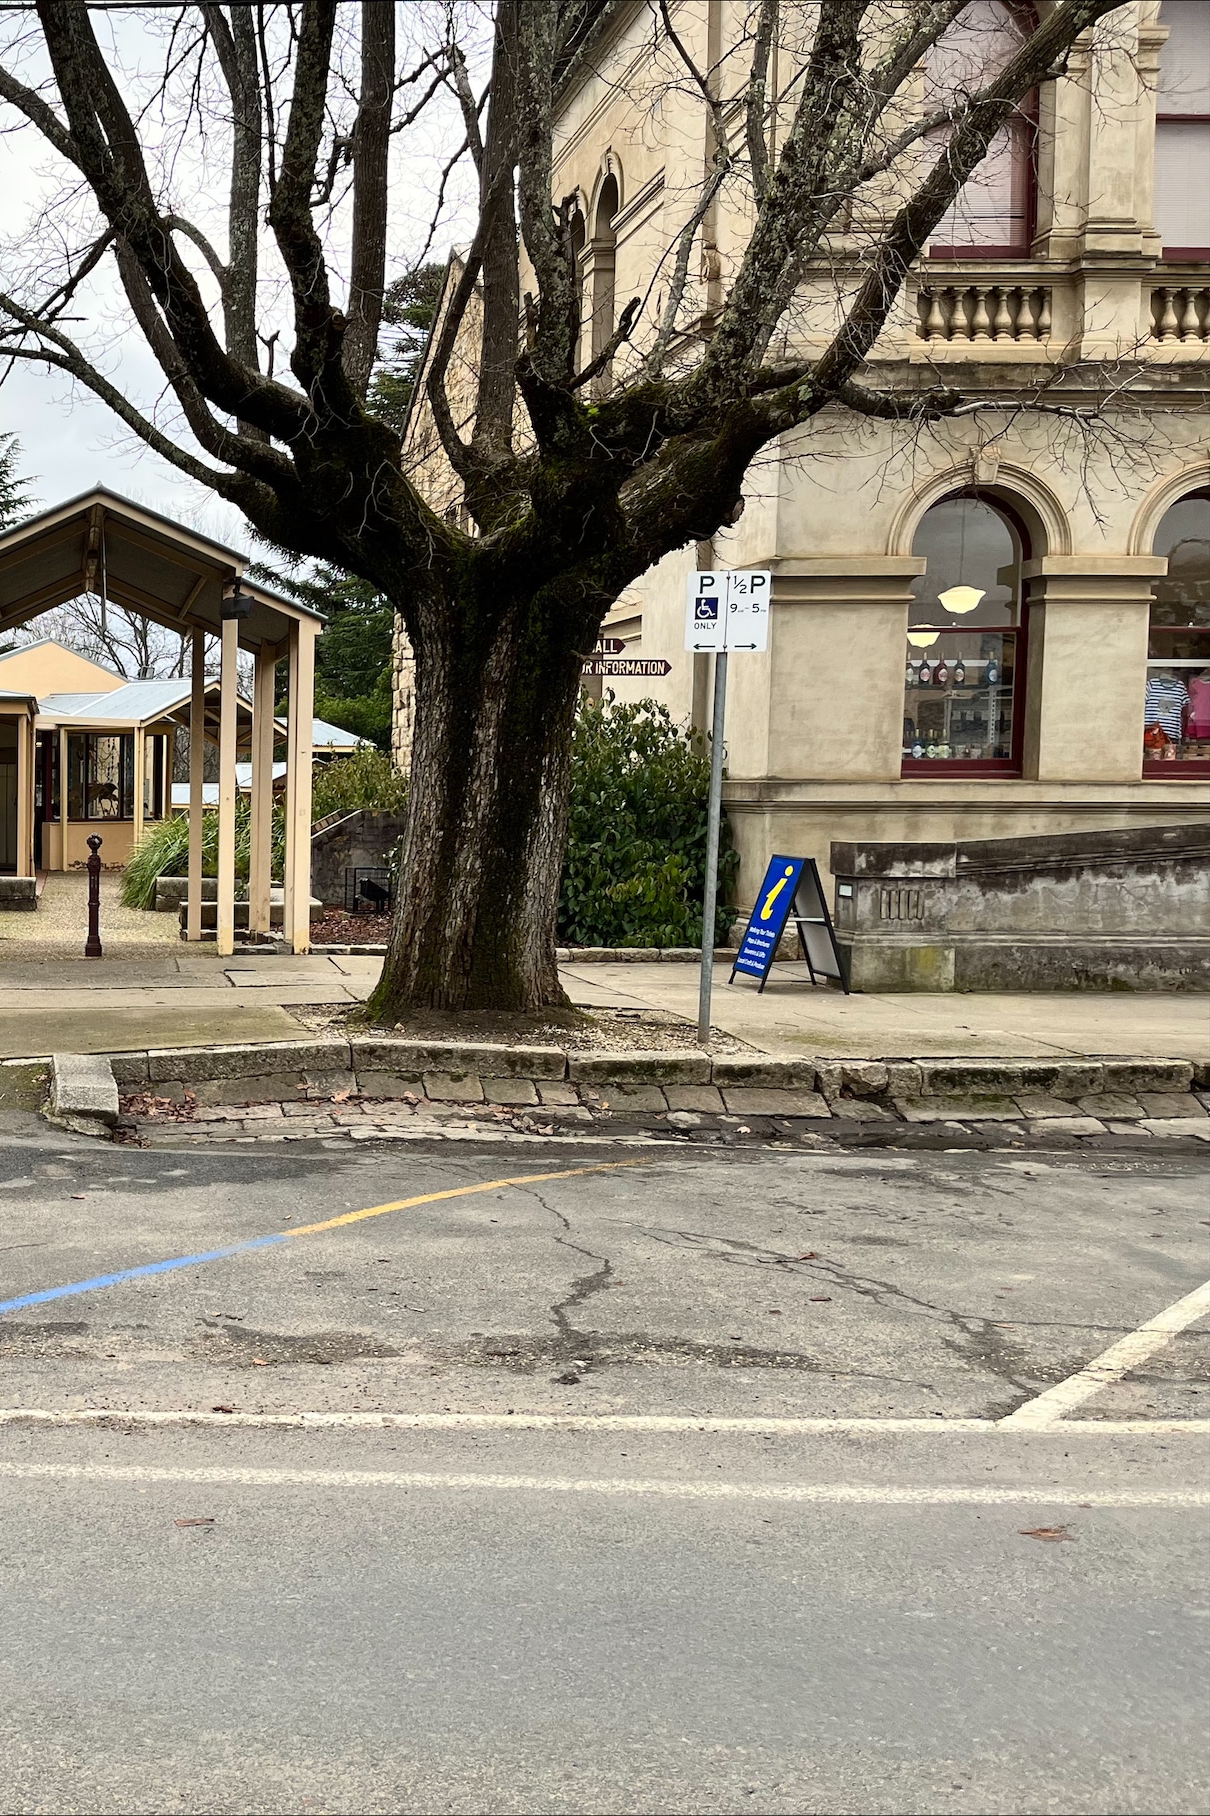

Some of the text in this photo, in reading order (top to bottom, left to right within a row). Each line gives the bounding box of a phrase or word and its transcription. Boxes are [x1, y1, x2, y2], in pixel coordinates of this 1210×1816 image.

[700, 575, 715, 595] P
[694, 622, 717, 630] ONLY
[592, 640, 618, 654] ALL
[595, 661, 666, 675] INFORMATION
